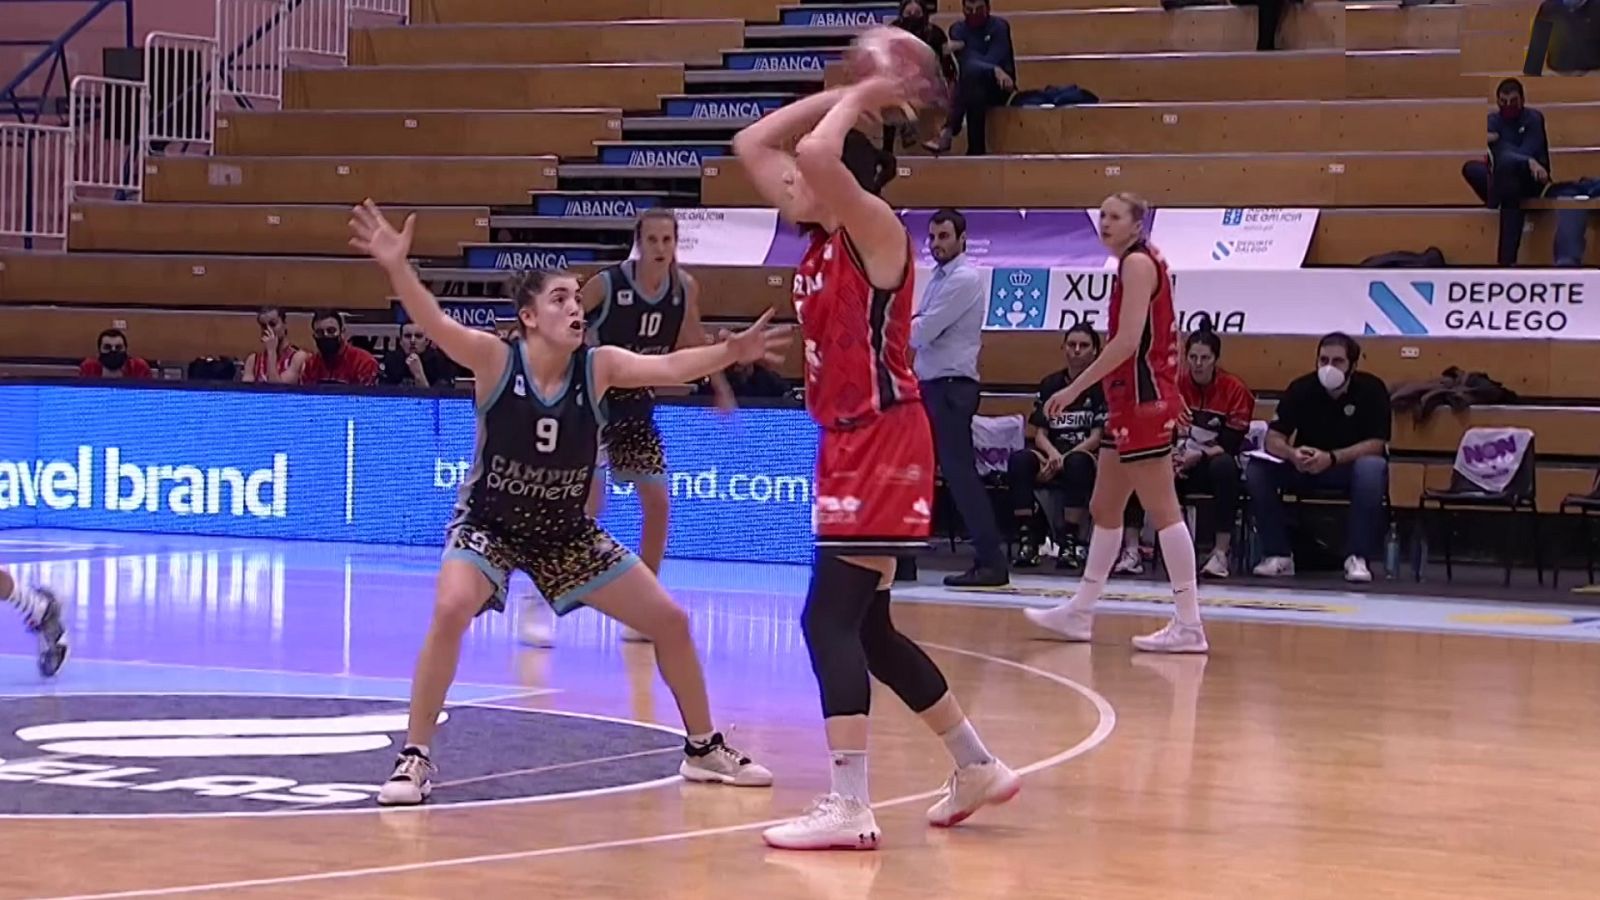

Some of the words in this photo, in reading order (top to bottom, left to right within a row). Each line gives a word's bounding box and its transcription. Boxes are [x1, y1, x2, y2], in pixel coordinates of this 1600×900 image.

[1448, 282, 1584, 304] DEPORTE
[638, 312, 662, 337] 10
[1445, 309, 1567, 331] GALEGO
[536, 417, 558, 452] 9
[105, 447, 288, 518] brand
